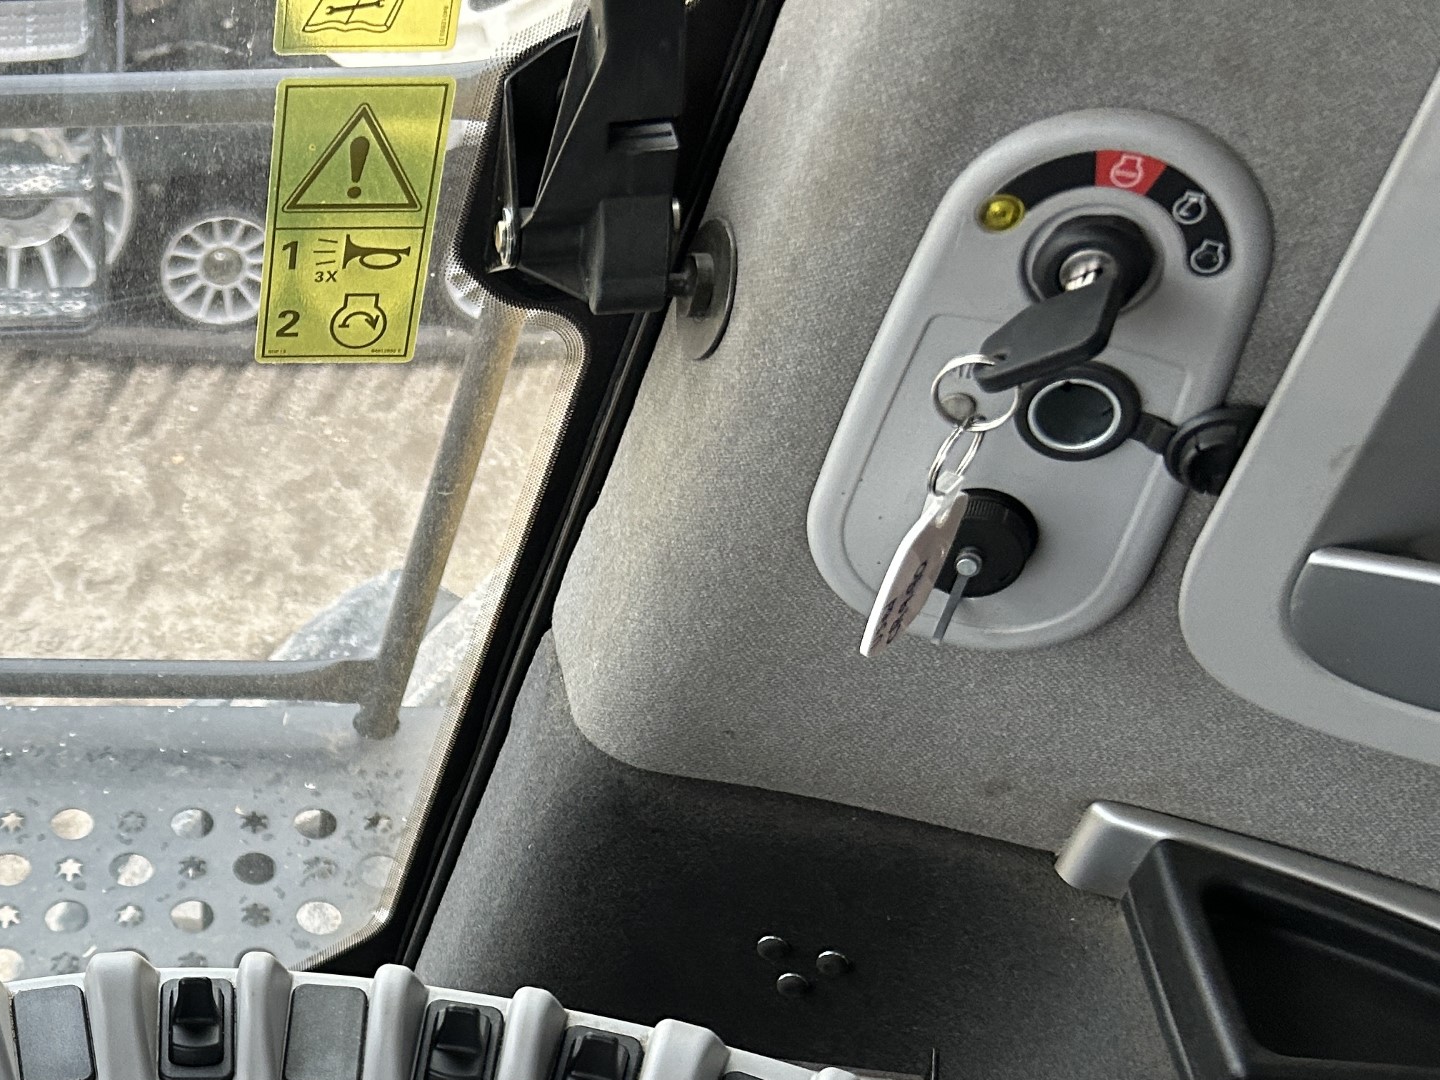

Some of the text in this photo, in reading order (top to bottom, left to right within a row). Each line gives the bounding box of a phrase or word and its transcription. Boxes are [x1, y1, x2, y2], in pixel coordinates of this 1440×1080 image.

[282, 240, 339, 283] 1 3X
[276, 309, 301, 338] 2
